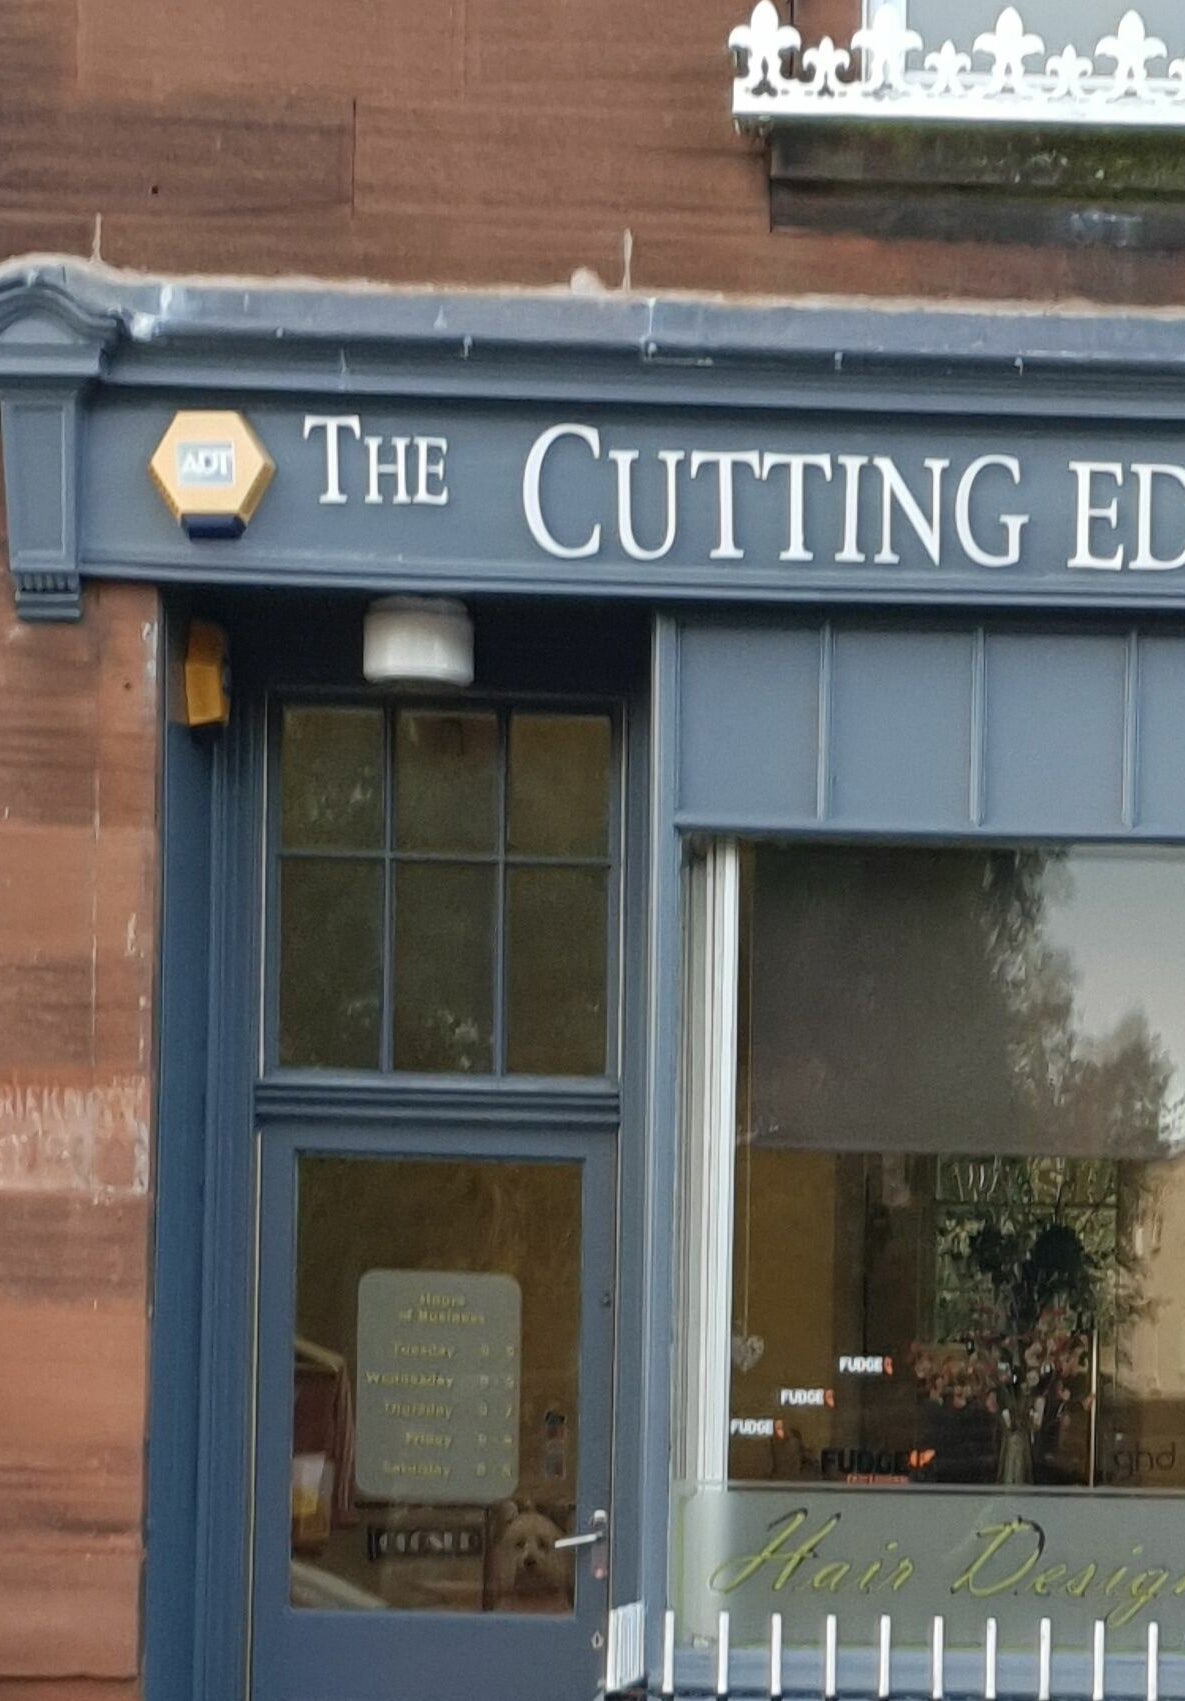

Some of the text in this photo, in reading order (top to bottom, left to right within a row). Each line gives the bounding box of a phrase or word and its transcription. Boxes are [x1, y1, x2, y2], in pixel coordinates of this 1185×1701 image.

[180, 448, 231, 475] ADT
[522, 422, 1030, 568] CUTTING
[839, 1356, 883, 1374] FUDGE
[780, 1388, 825, 1406] FUDGE
[730, 1418, 774, 1435] FUDGE
[708, 1508, 914, 1597] Hair
